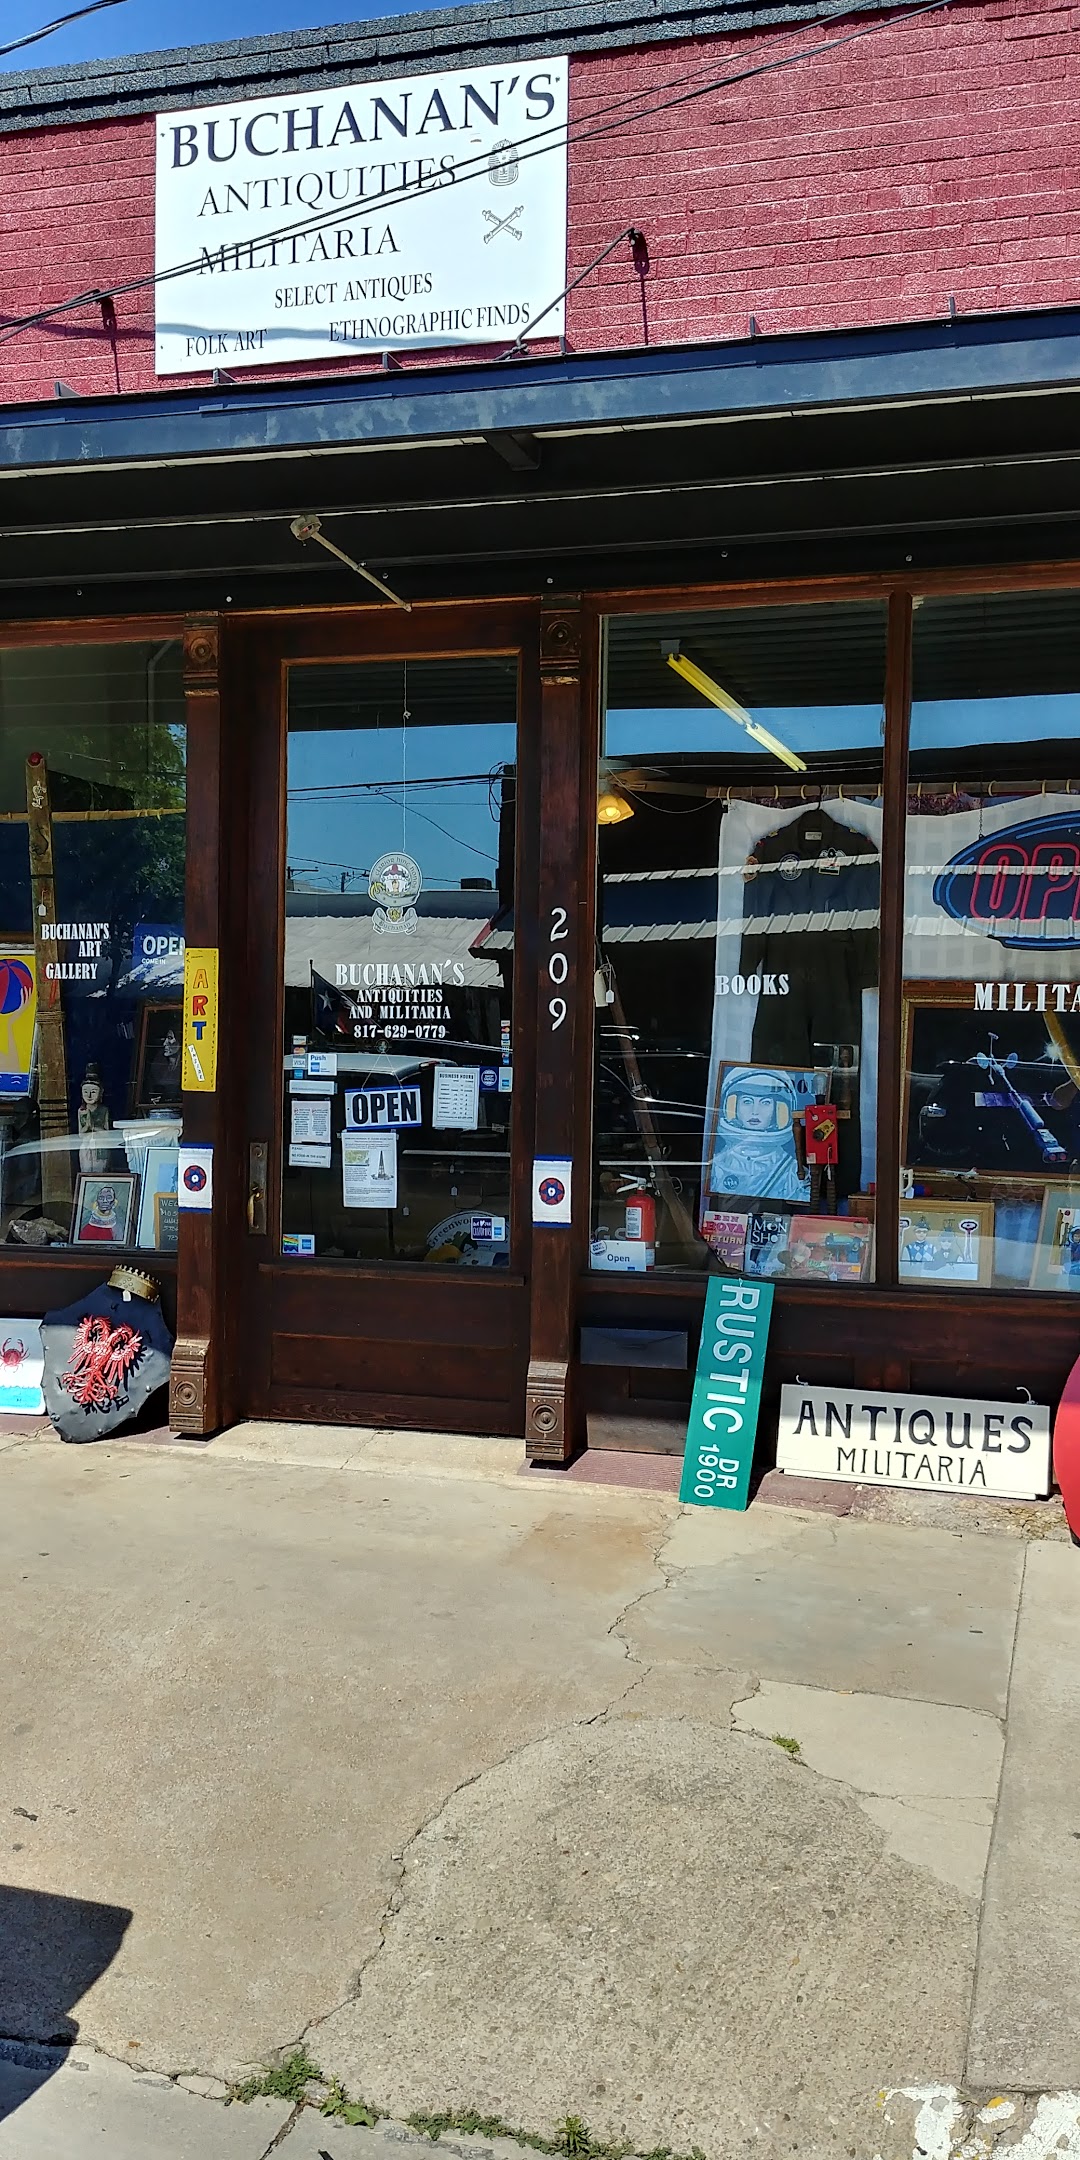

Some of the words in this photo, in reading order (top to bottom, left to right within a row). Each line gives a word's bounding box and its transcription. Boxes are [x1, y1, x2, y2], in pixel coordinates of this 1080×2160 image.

[170, 73, 556, 169] BUCHANAN'S
[196, 154, 457, 218] ANTIQUITIES
[196, 223, 402, 276] MILITARIA
[274, 281, 339, 309] SELECT
[343, 272, 433, 302] ANTIQUES
[329, 306, 474, 343] ETHNOGRAPHIC
[476, 302, 531, 328] FINDS
[186, 334, 229, 358] FOLK
[233, 328, 268, 351] ART
[41, 922, 110, 941] BUCHANAN'S
[78, 940, 103, 958] ART
[141, 957, 159, 965] COME
[45, 962, 99, 980] GALLERY
[335, 959, 466, 987] BUCHANAN'S
[548, 907, 569, 1032] 209
[714, 973, 791, 996] BOOKS
[191, 968, 209, 1041] ART
[356, 988, 443, 1004] ANTIQUITIES
[349, 1005, 373, 1020] AND
[379, 1005, 452, 1020] MILITARIA
[353, 1024, 447, 1039] 817-629-0779
[352, 1090, 418, 1125] OPEN
[427, 1218, 470, 1249] Greenwo
[704, 1221, 745, 1234] BOVA
[714, 1214, 740, 1223] BEN
[607, 1253, 630, 1263] Open
[716, 1247, 728, 1256] TO
[702, 1283, 760, 1434] RUSTIC
[793, 1400, 1034, 1454] ANTIQUES
[694, 1443, 721, 1498] 1900
[716, 1458, 740, 1490] DR
[836, 1447, 988, 1487] MILITARIA
